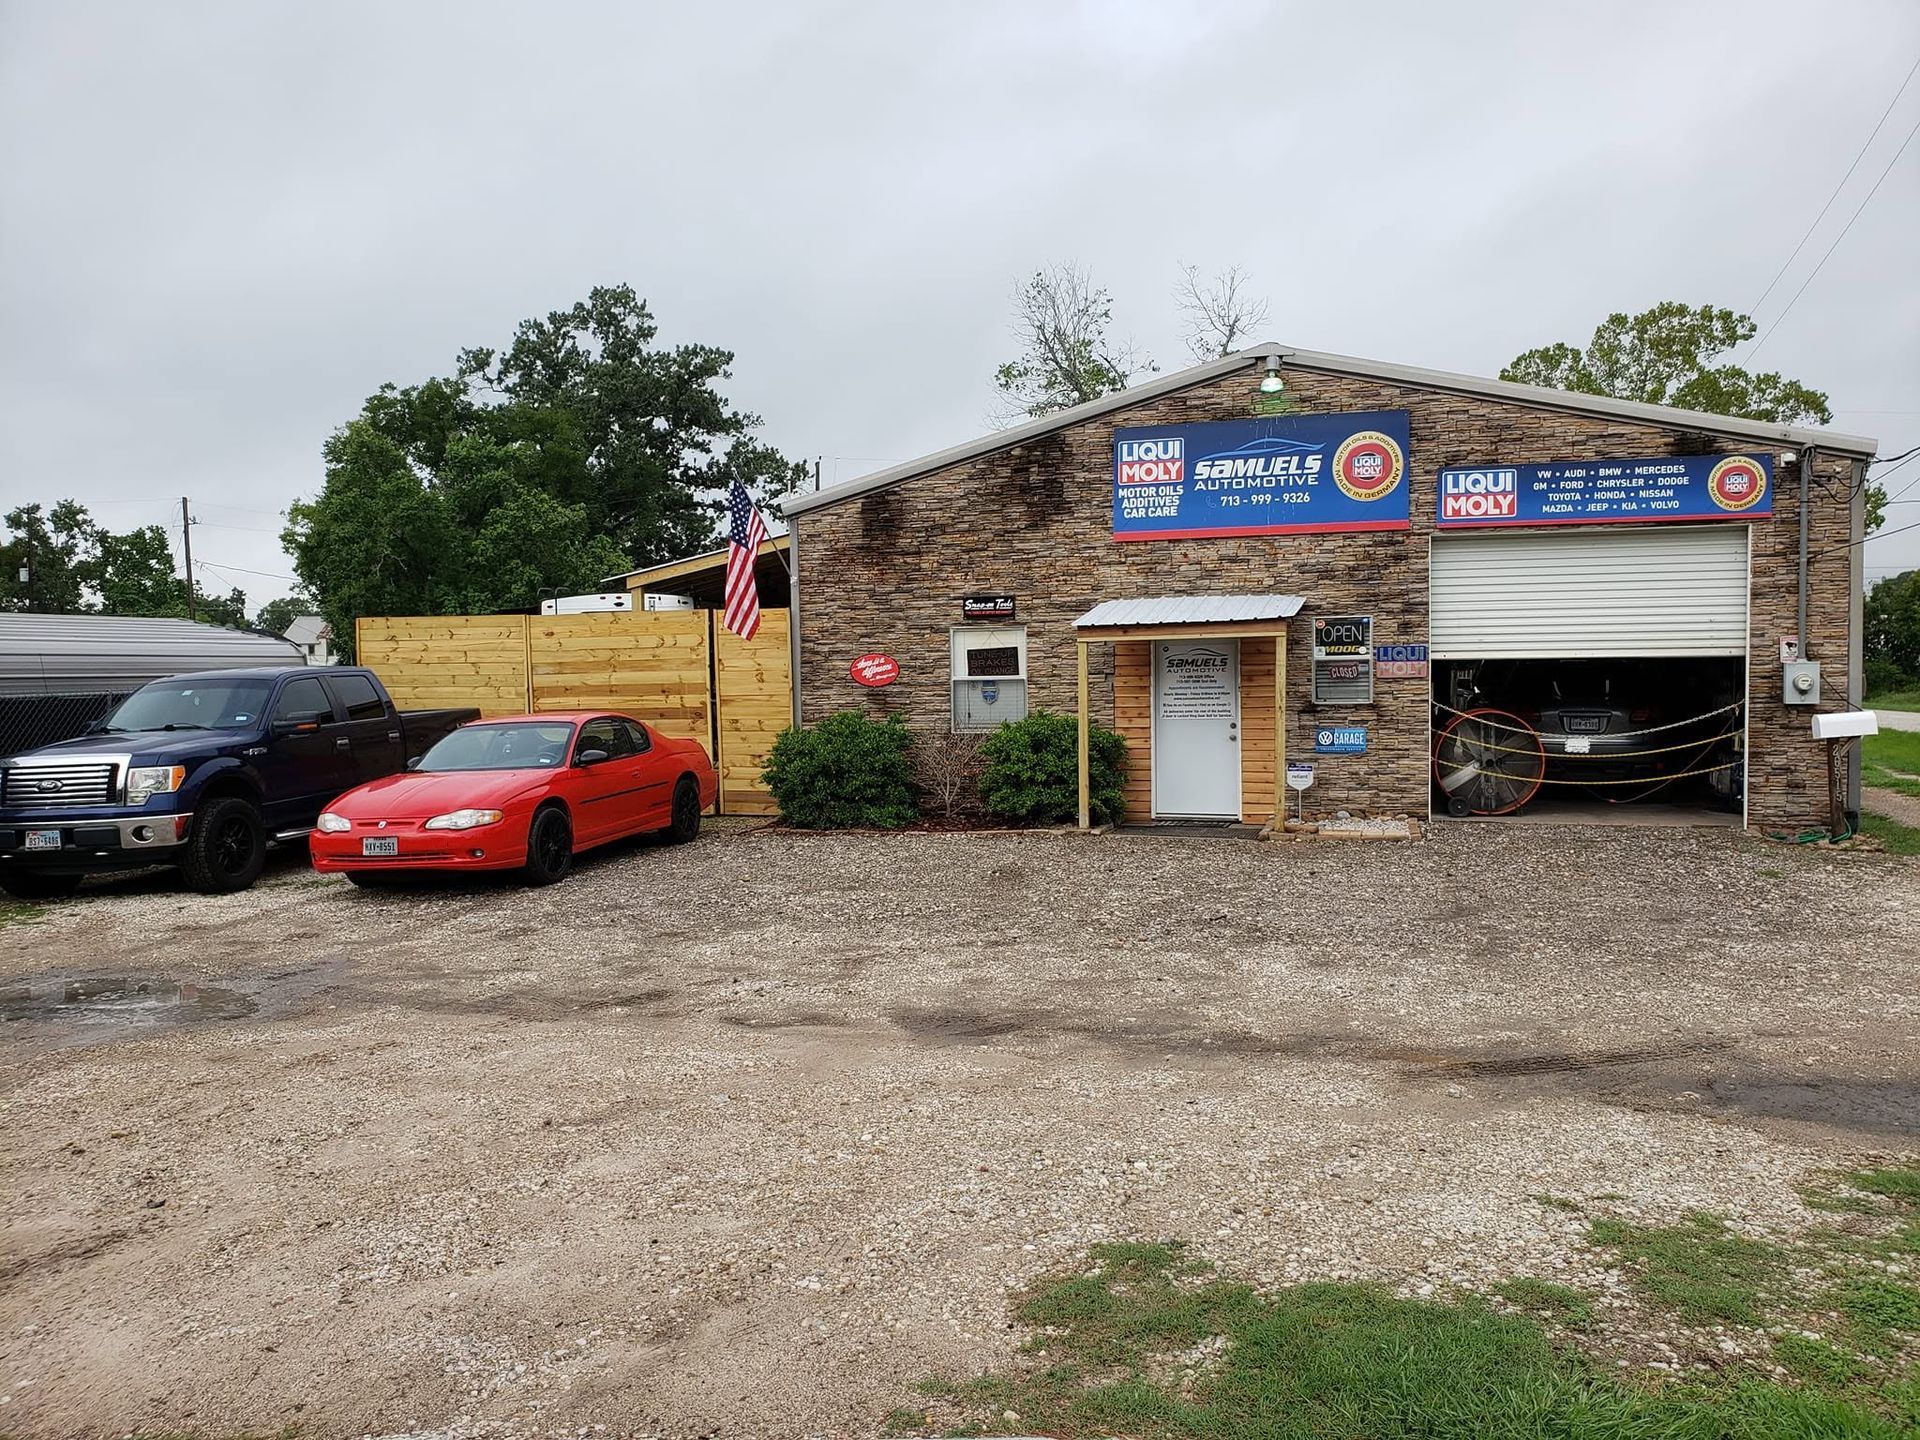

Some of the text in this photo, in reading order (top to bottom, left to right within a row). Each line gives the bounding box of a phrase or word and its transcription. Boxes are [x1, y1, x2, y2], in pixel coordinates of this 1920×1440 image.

[1122, 440, 1181, 461] LIQUI
[1336, 442, 1352, 466] MOTOR
[1374, 436, 1400, 463] ADDITIVES
[1354, 457, 1381, 467] LIQUI
[1122, 461, 1182, 482] MOLY
[1354, 466, 1382, 475] MOLY
[1537, 465, 1685, 479] VW AUDI BMW MERCEDES
[1194, 474, 1319, 491] AUTOMOTIVE
[1335, 470, 1353, 494] MADE
[1364, 466, 1401, 499] GERMANY
[1446, 472, 1513, 494] LIQUI
[1533, 477, 1689, 490] GM FORD CHRYSLER DODGE
[1726, 476, 1748, 484] LIQUI
[1118, 485, 1184, 498] MOTOR OILS
[1548, 489, 1674, 501] TOYOTA HONDA NISSAN
[1121, 496, 1180, 508] ADDITIVES
[1220, 495, 1240, 507] 713
[1251, 494, 1272, 505] 999
[1282, 492, 1310, 503] 9326
[1446, 494, 1514, 516] MOLY
[1123, 506, 1178, 518] CAR CARE
[1542, 500, 1680, 513] MAZDA JEEP KIA VOLVO
[964, 598, 1013, 610] Snap-on Tools
[1322, 625, 1362, 642] OPEN
[1325, 645, 1359, 653] MOOG
[1379, 646, 1425, 661] LIQUI
[970, 658, 1015, 667] BRAKES
[1331, 666, 1358, 678] CLOSED
[1333, 732, 1364, 745] GARAGE
